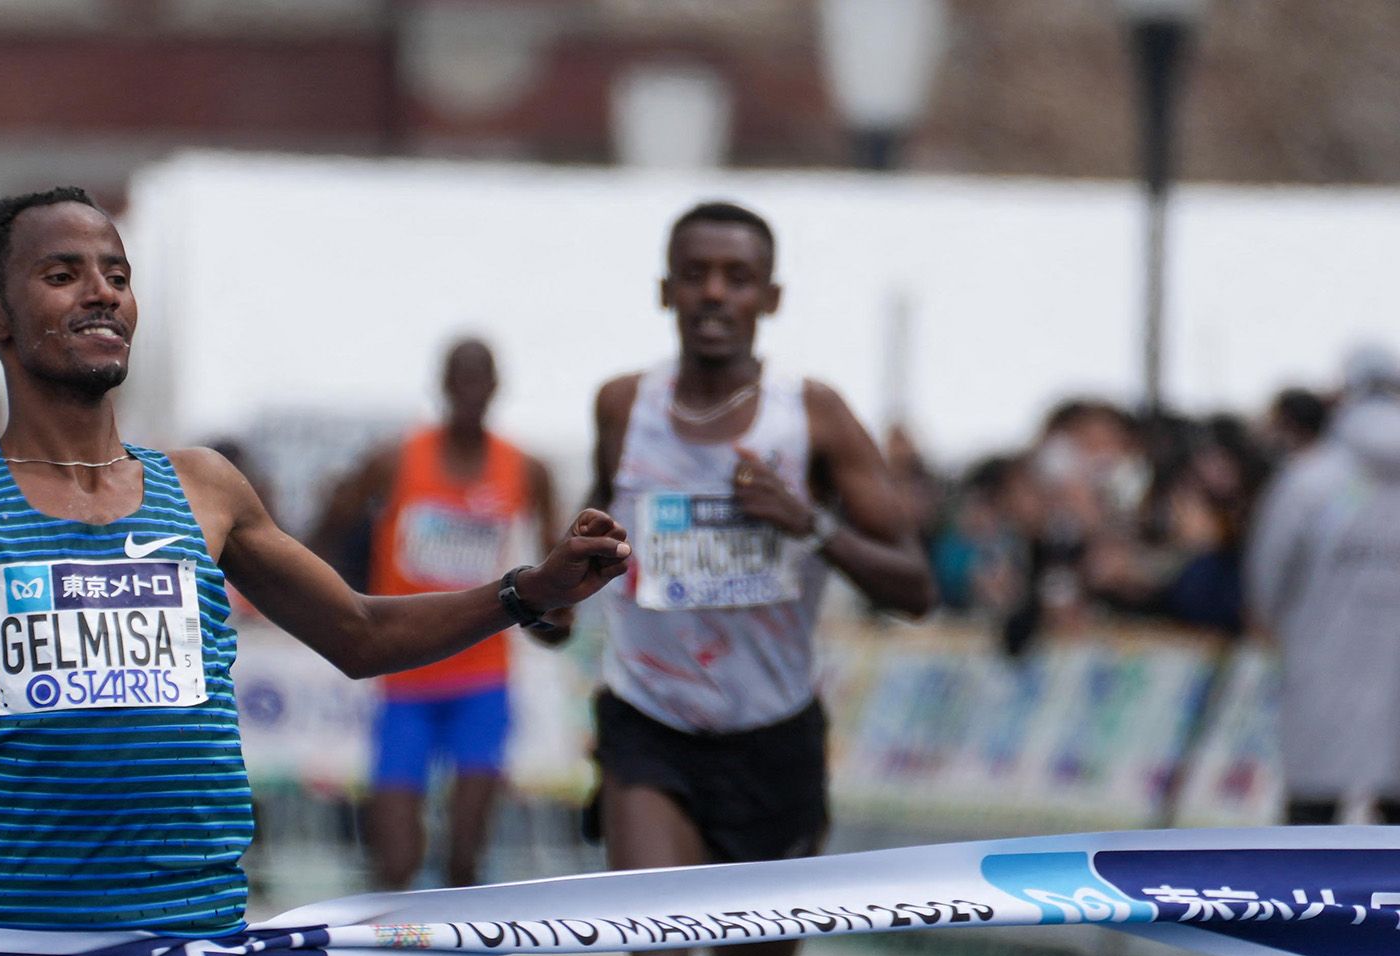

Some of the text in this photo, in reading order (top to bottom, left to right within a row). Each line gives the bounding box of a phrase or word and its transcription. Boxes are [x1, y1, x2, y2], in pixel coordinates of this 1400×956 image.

[61, 574, 174, 599] 東京メトロ
[1, 610, 177, 675] GELMISA
[599, 904, 874, 946] MARATHON
